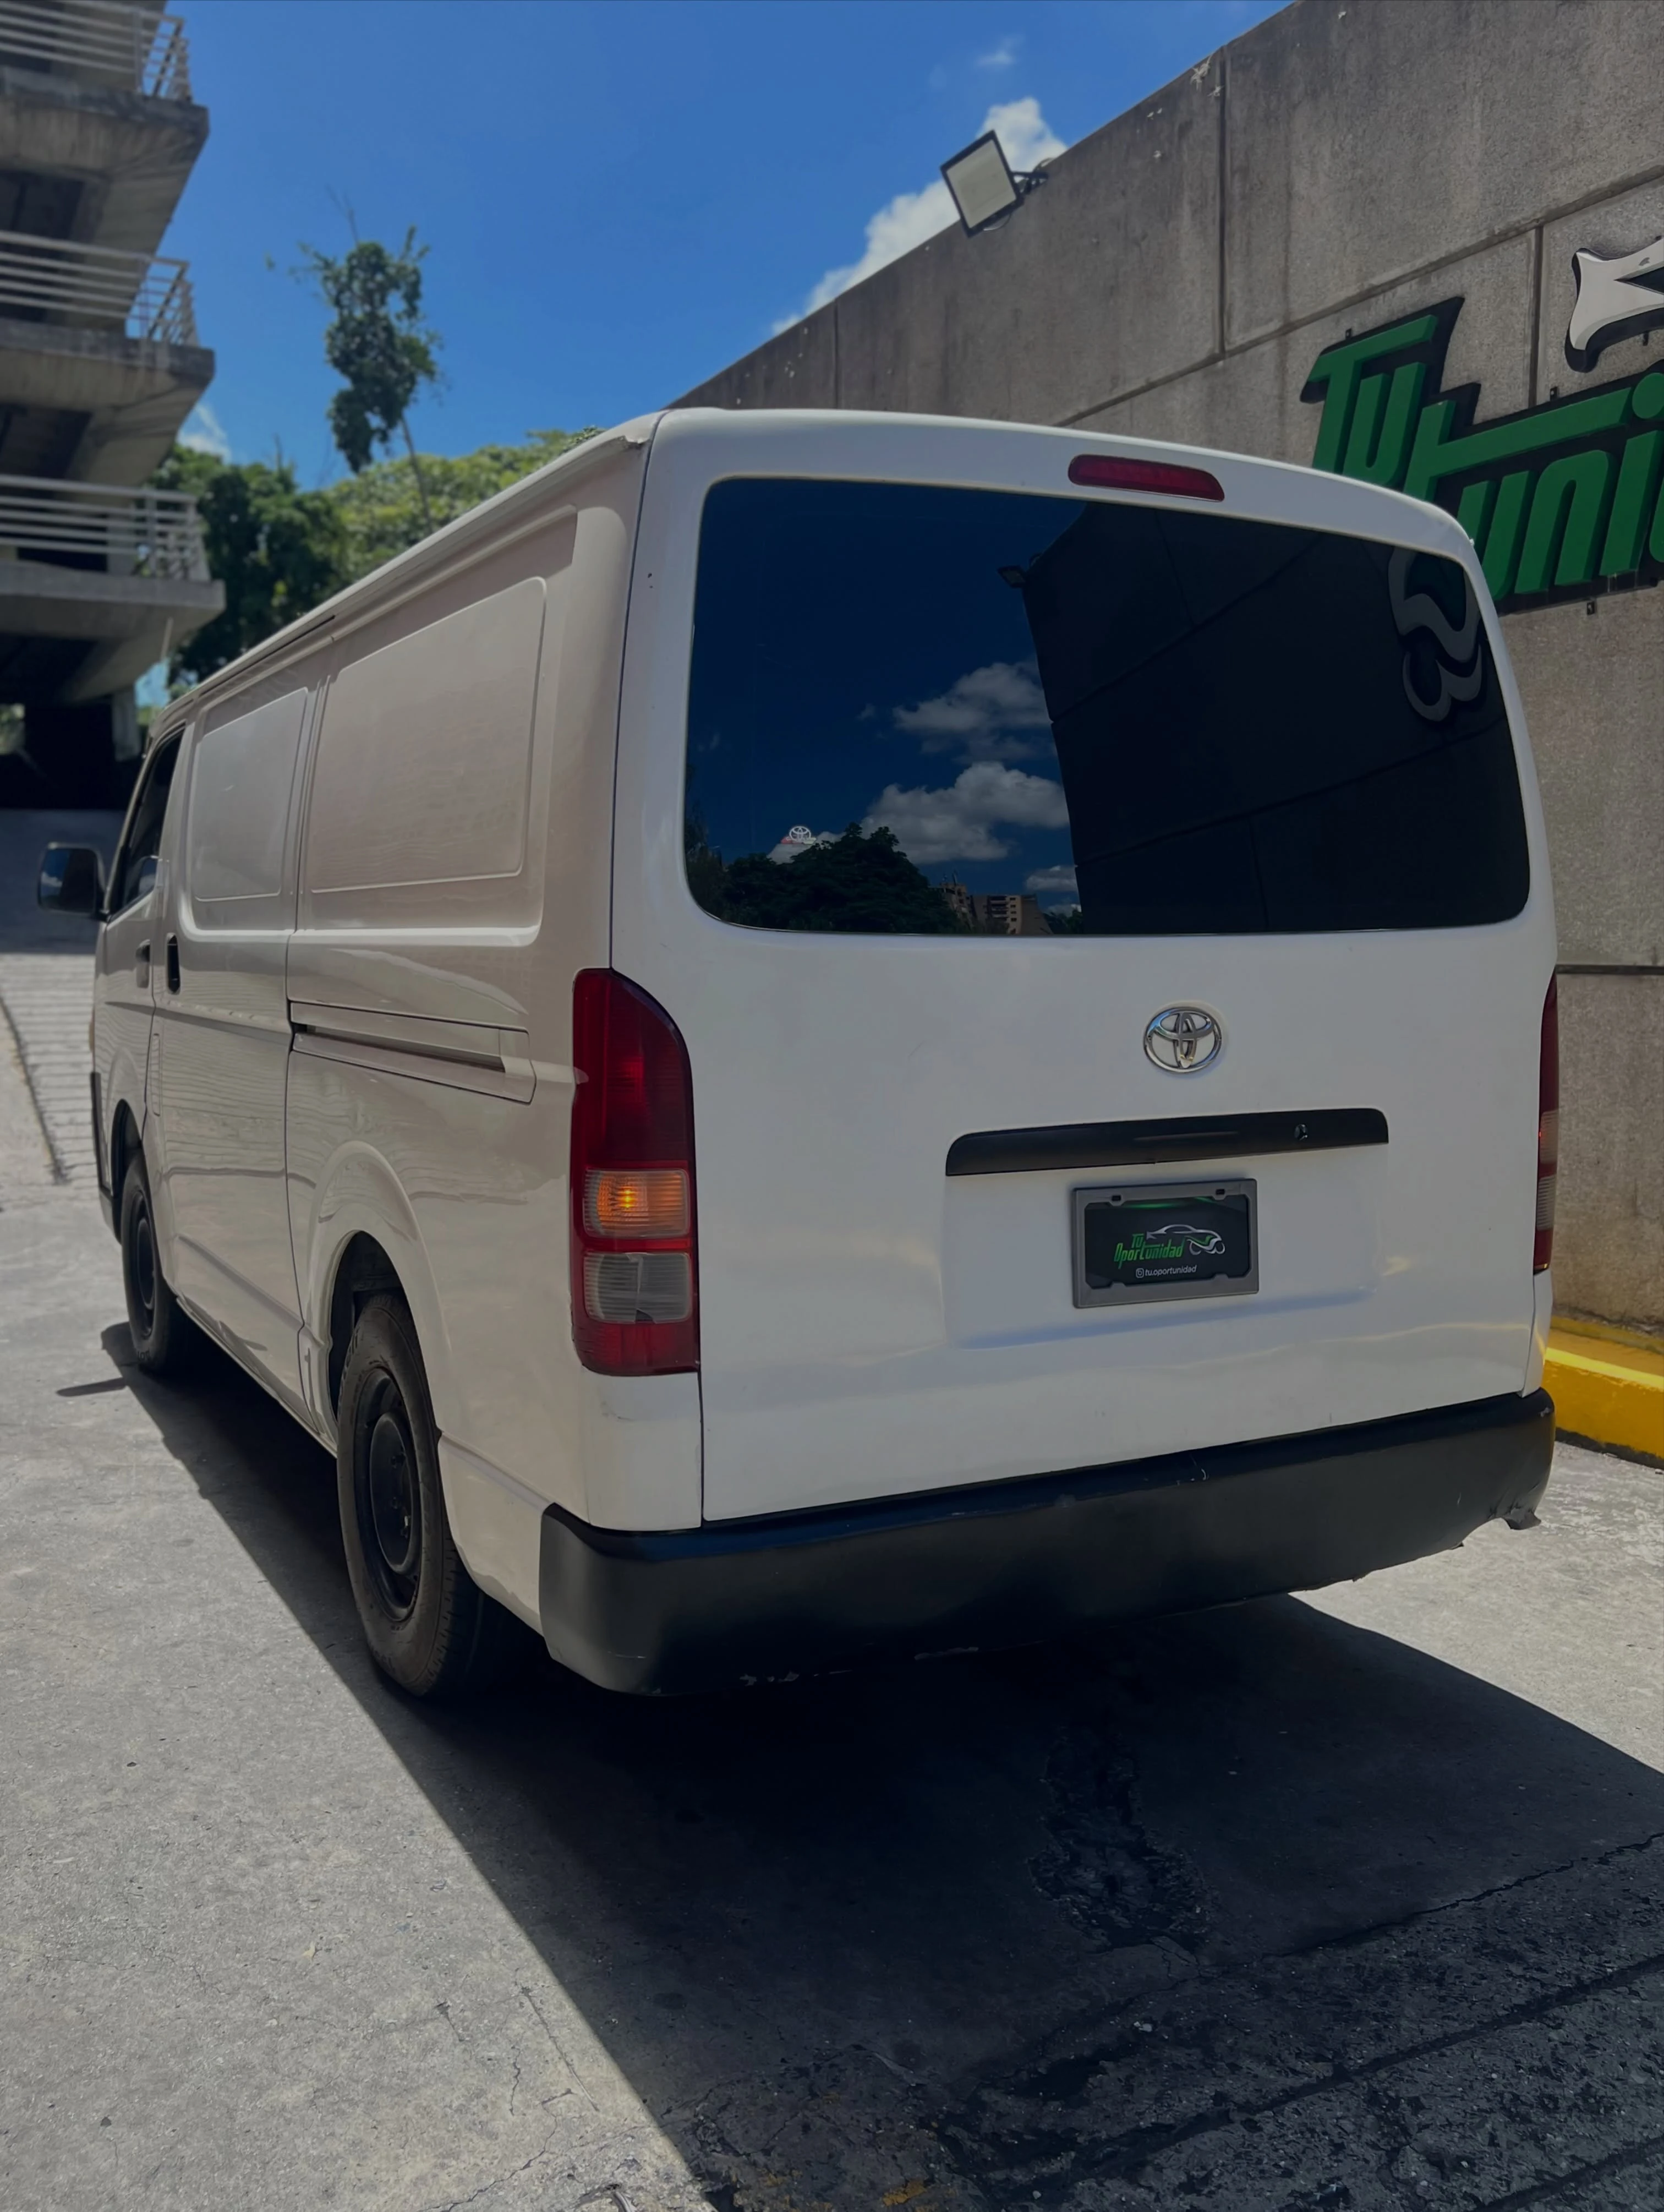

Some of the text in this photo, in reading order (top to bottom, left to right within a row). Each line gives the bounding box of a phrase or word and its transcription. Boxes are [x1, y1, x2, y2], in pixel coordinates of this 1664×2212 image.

[1402, 372, 1664, 602] tuni
[1114, 1238, 1185, 1269] Oportunidad
[1145, 1265, 1197, 1276] tu.oportunidad
